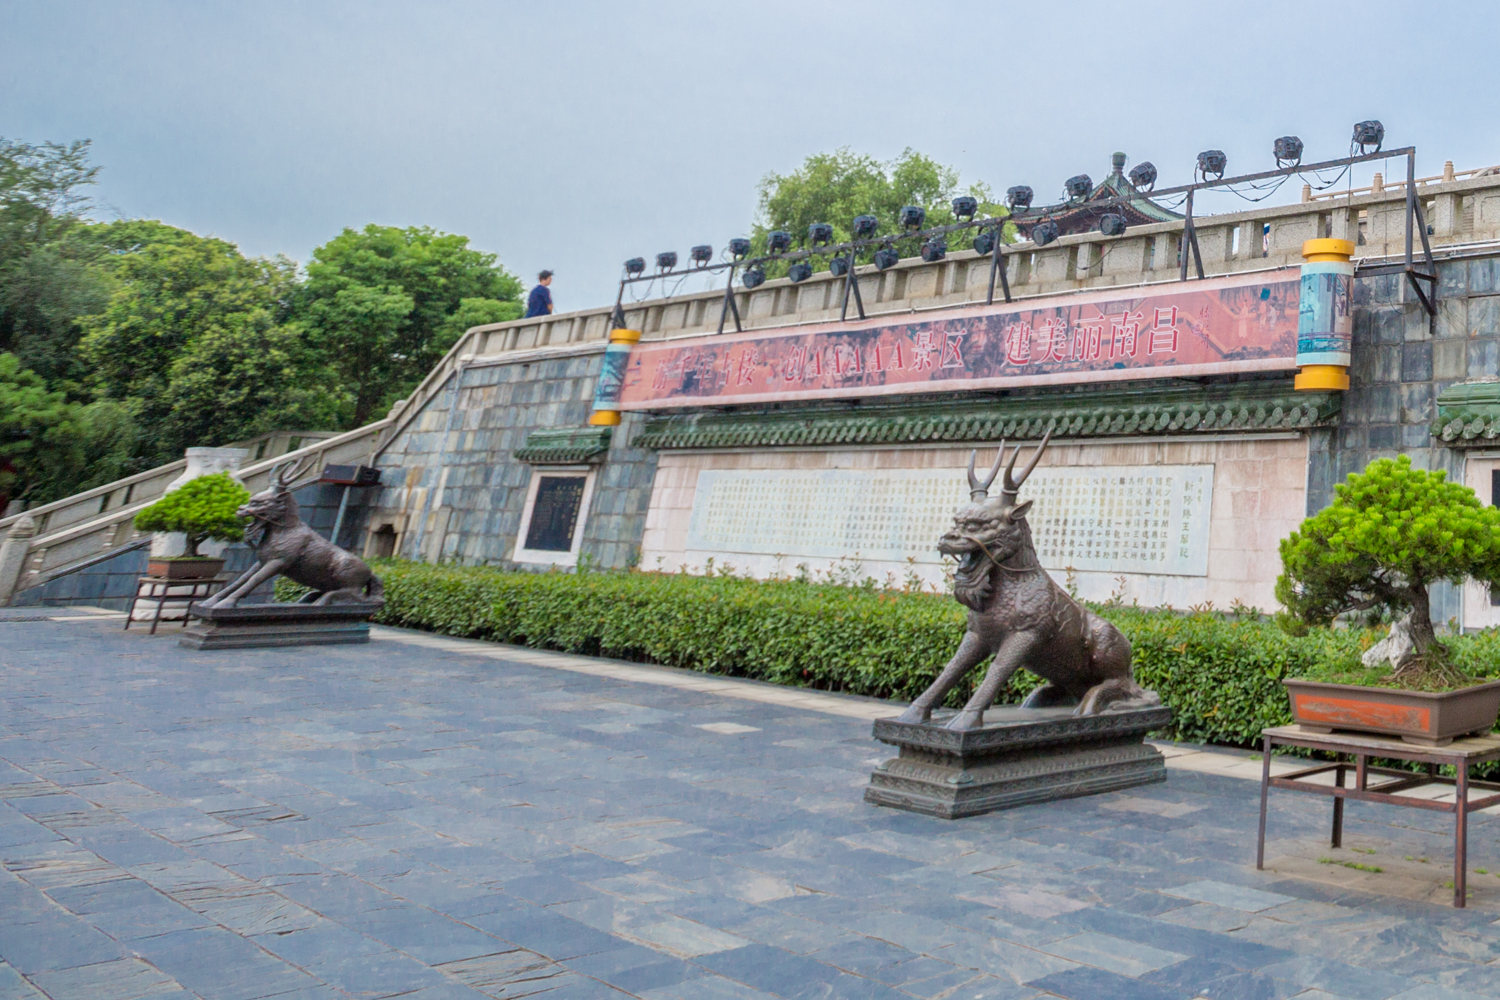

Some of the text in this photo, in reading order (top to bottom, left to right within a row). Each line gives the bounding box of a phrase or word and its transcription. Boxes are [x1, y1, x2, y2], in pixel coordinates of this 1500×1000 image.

[1000, 305, 1180, 367] 建美丽南昌
